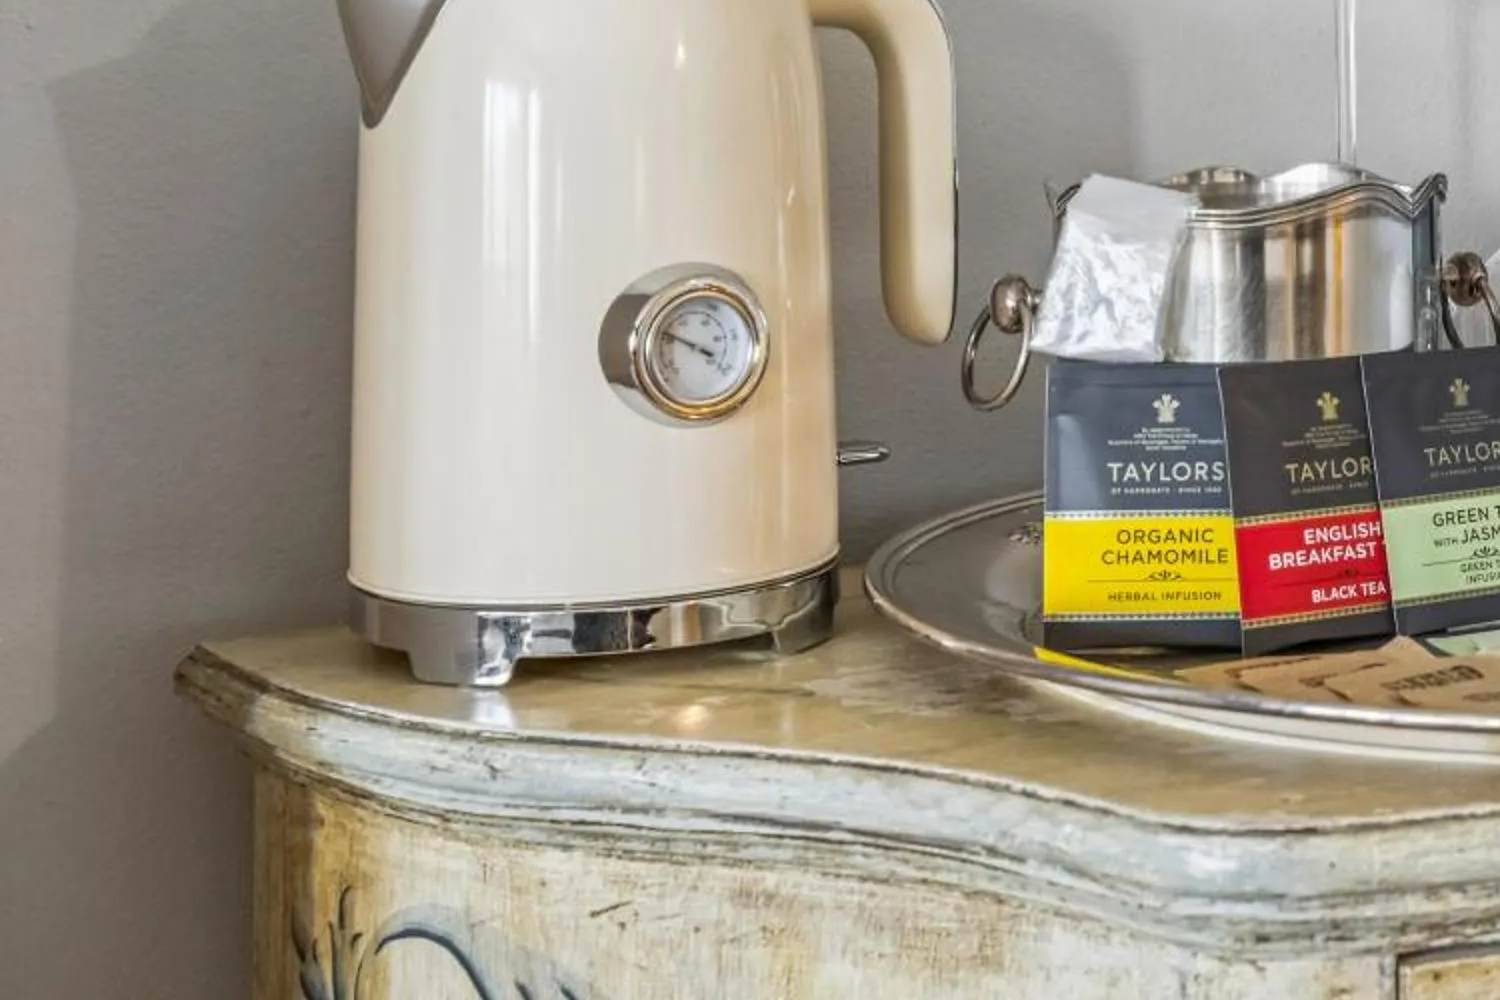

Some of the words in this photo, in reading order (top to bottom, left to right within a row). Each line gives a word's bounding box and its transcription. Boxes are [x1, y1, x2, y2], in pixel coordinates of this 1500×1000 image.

[1107, 461, 1225, 482] TAYLORS
[1285, 456, 1372, 483] TAYLOR
[1432, 507, 1489, 527] GREEN
[1116, 528, 1214, 545] ORGANIC
[1304, 521, 1381, 545] ENGLISH
[1433, 538, 1458, 547] WITH
[1101, 548, 1229, 565] CHAMOMILE
[1268, 541, 1377, 571] BREAKFAST
[1460, 562, 1493, 573] GREEN
[1107, 591, 1157, 601] HERBAL
[1161, 591, 1222, 601] INFUSION
[1312, 584, 1357, 603] BLACK
[1360, 580, 1386, 597] TEA
